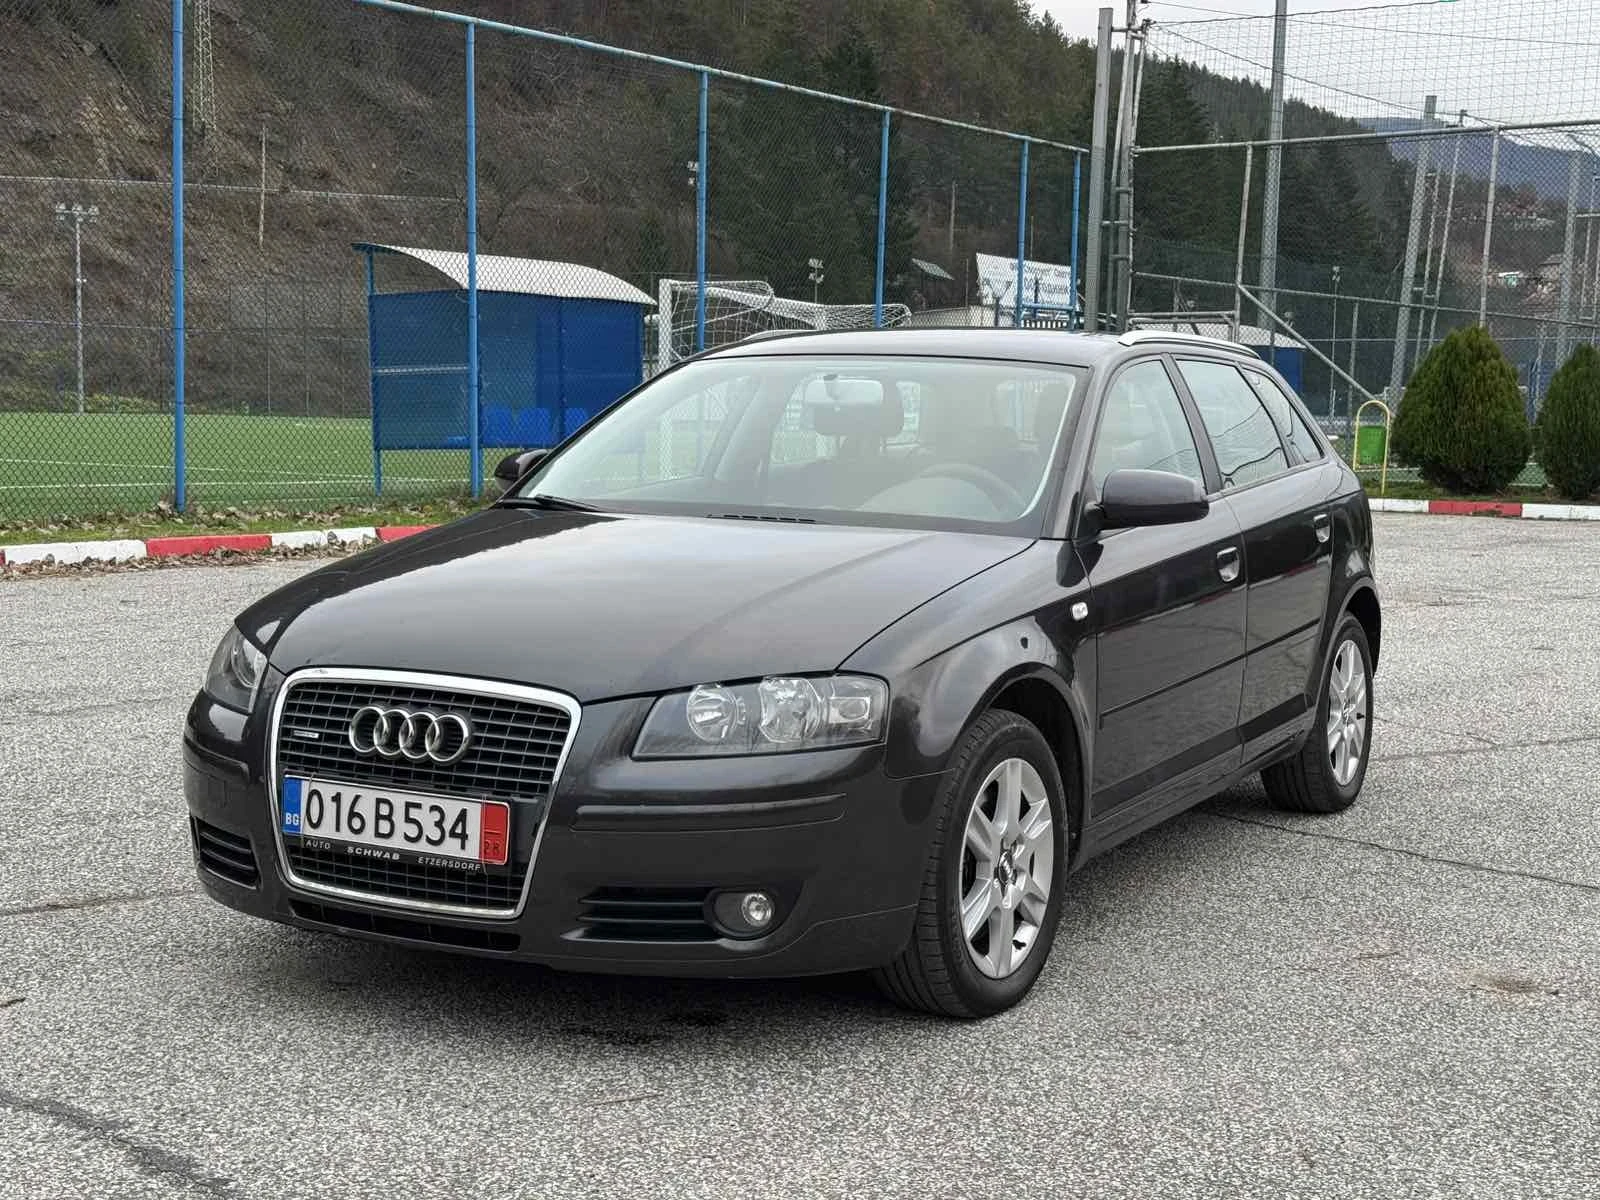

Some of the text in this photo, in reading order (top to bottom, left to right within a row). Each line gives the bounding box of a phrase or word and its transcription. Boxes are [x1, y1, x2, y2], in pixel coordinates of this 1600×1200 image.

[285, 788, 469, 850] BG 016B534
[305, 839, 481, 872] AUTO SCHWAB ETZERSDORF
